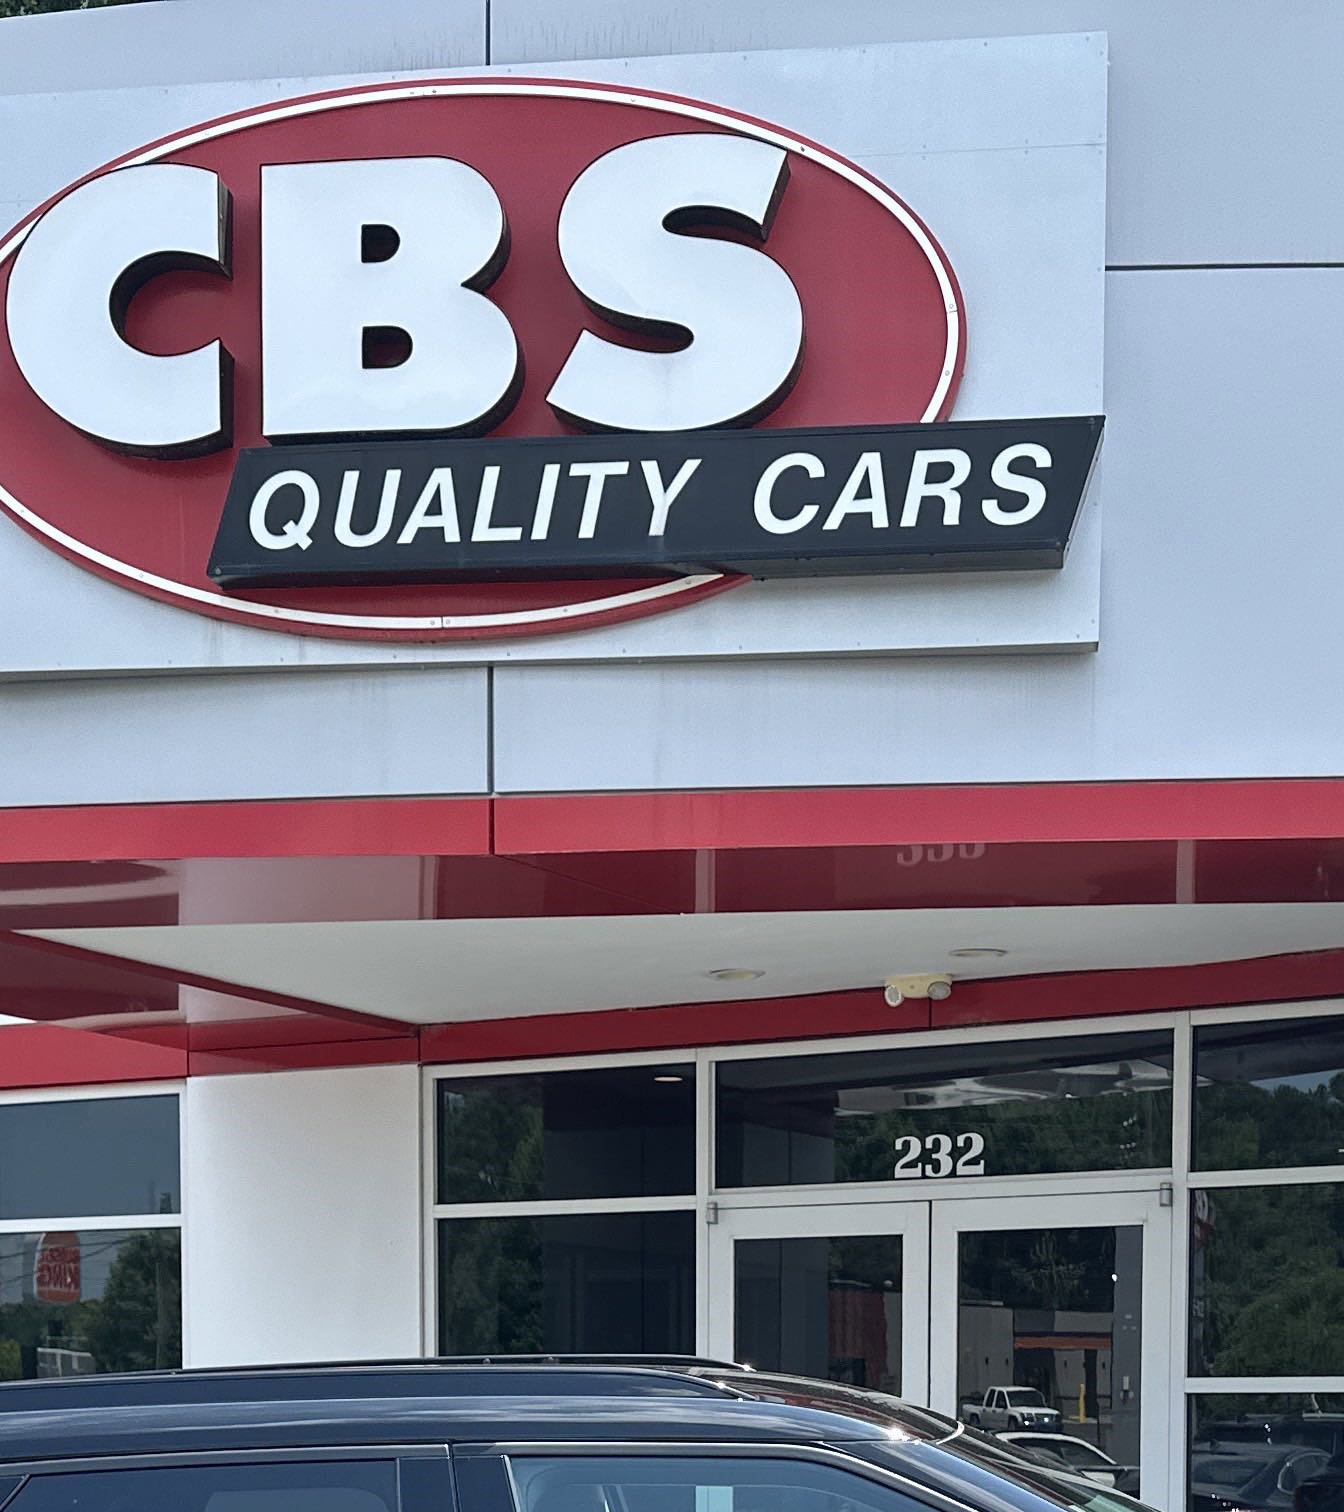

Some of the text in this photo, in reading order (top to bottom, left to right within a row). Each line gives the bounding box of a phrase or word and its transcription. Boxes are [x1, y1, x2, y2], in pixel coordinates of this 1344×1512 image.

[6, 131, 805, 455] CBS
[248, 443, 1052, 551] QUALITY CARS
[894, 1132, 985, 1178] 232
